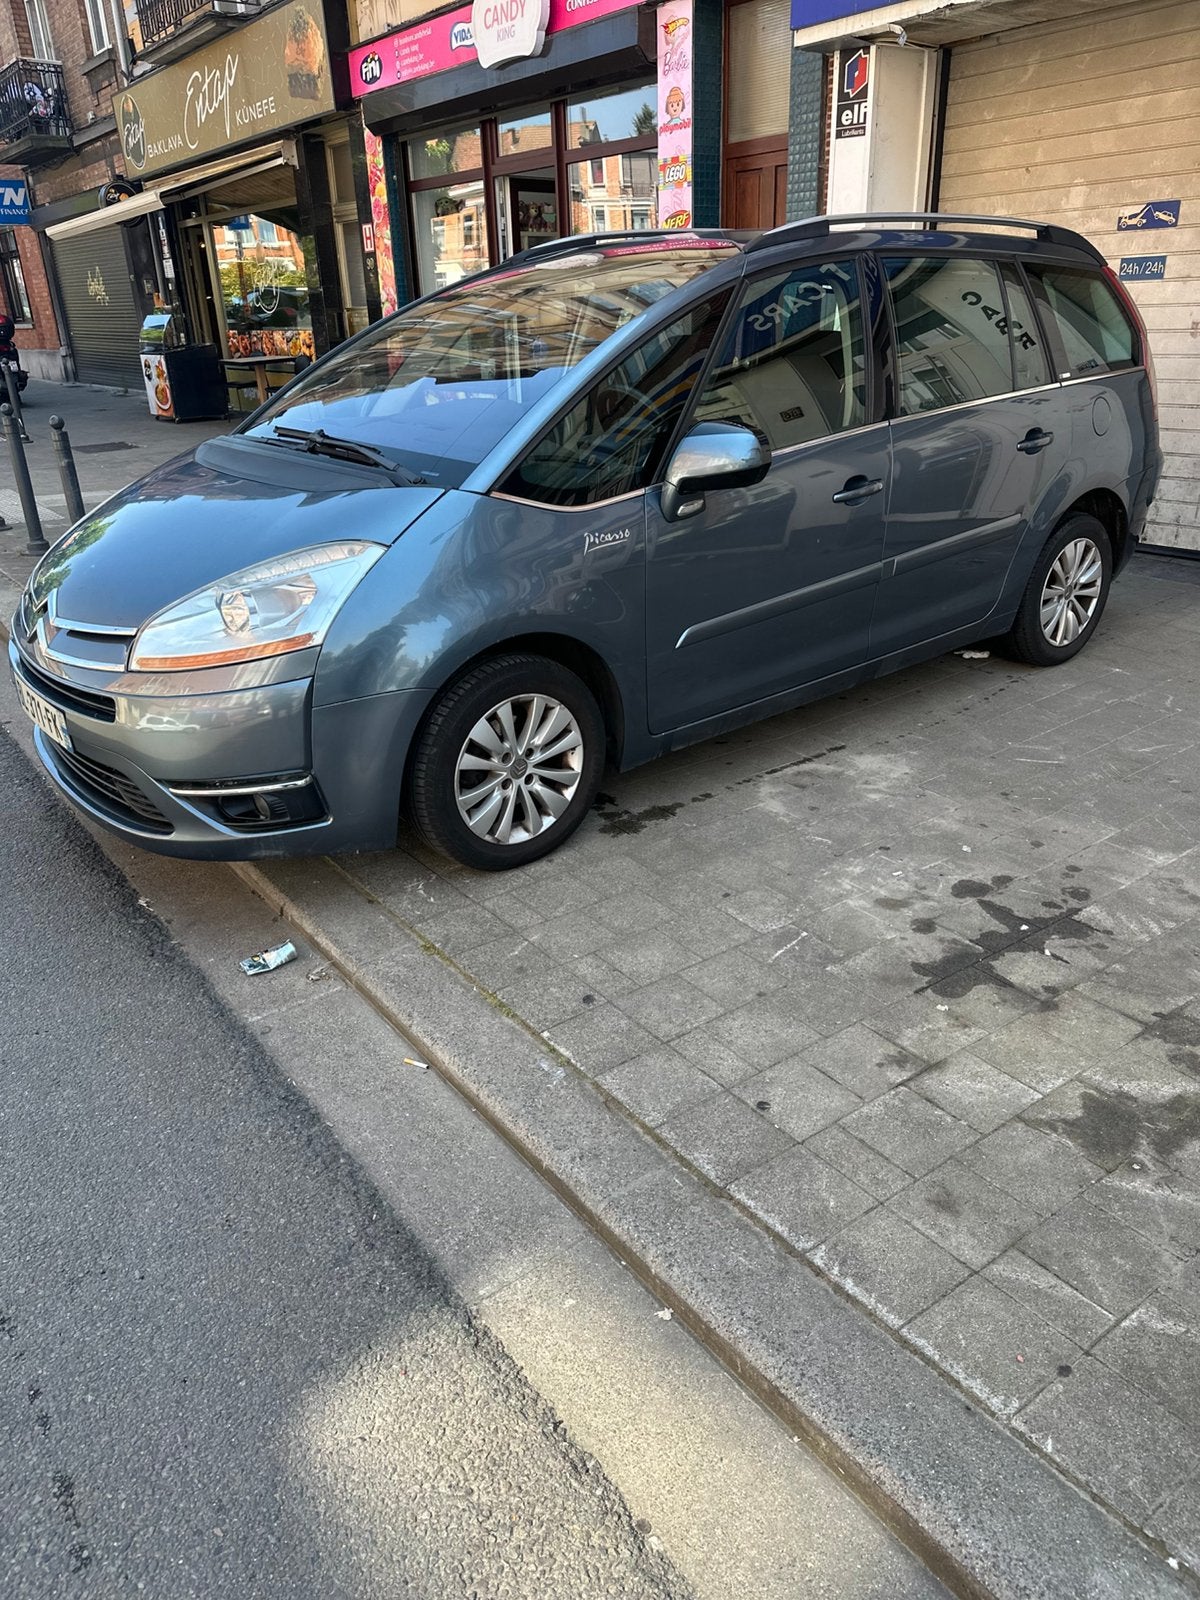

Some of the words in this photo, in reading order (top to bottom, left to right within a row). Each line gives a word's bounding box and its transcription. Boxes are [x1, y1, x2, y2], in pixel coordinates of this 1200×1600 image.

[483, 0, 526, 30] CANDY
[496, 24, 516, 43] KING
[841, 102, 868, 126] elf
[659, 118, 691, 136] playmobil
[147, 134, 184, 158] BAKLAVA
[665, 164, 686, 182] LEGO
[661, 211, 690, 229] NERF
